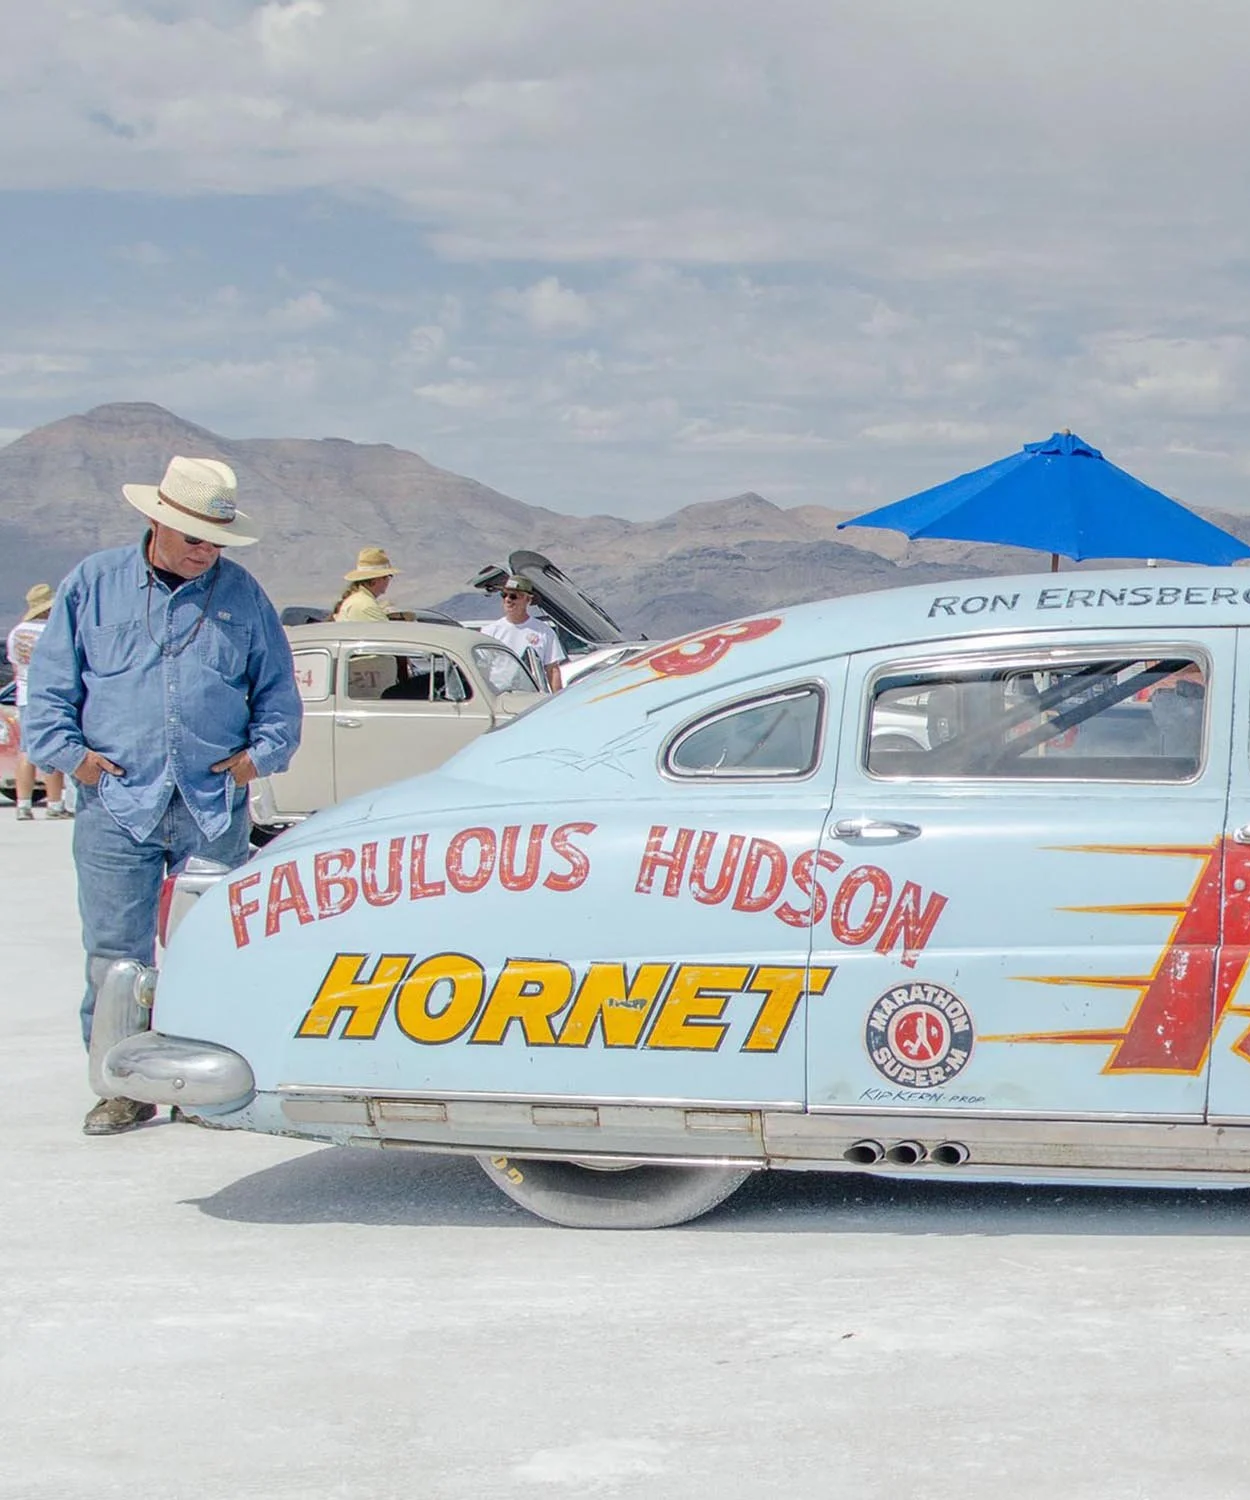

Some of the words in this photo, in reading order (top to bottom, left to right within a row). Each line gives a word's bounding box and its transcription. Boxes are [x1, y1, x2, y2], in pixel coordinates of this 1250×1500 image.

[927, 593, 1020, 617] RON
[226, 822, 599, 949] FABULOUS
[635, 824, 949, 969] HUDSON
[293, 952, 838, 1053] HORNET
[869, 984, 970, 1034] MARATHON
